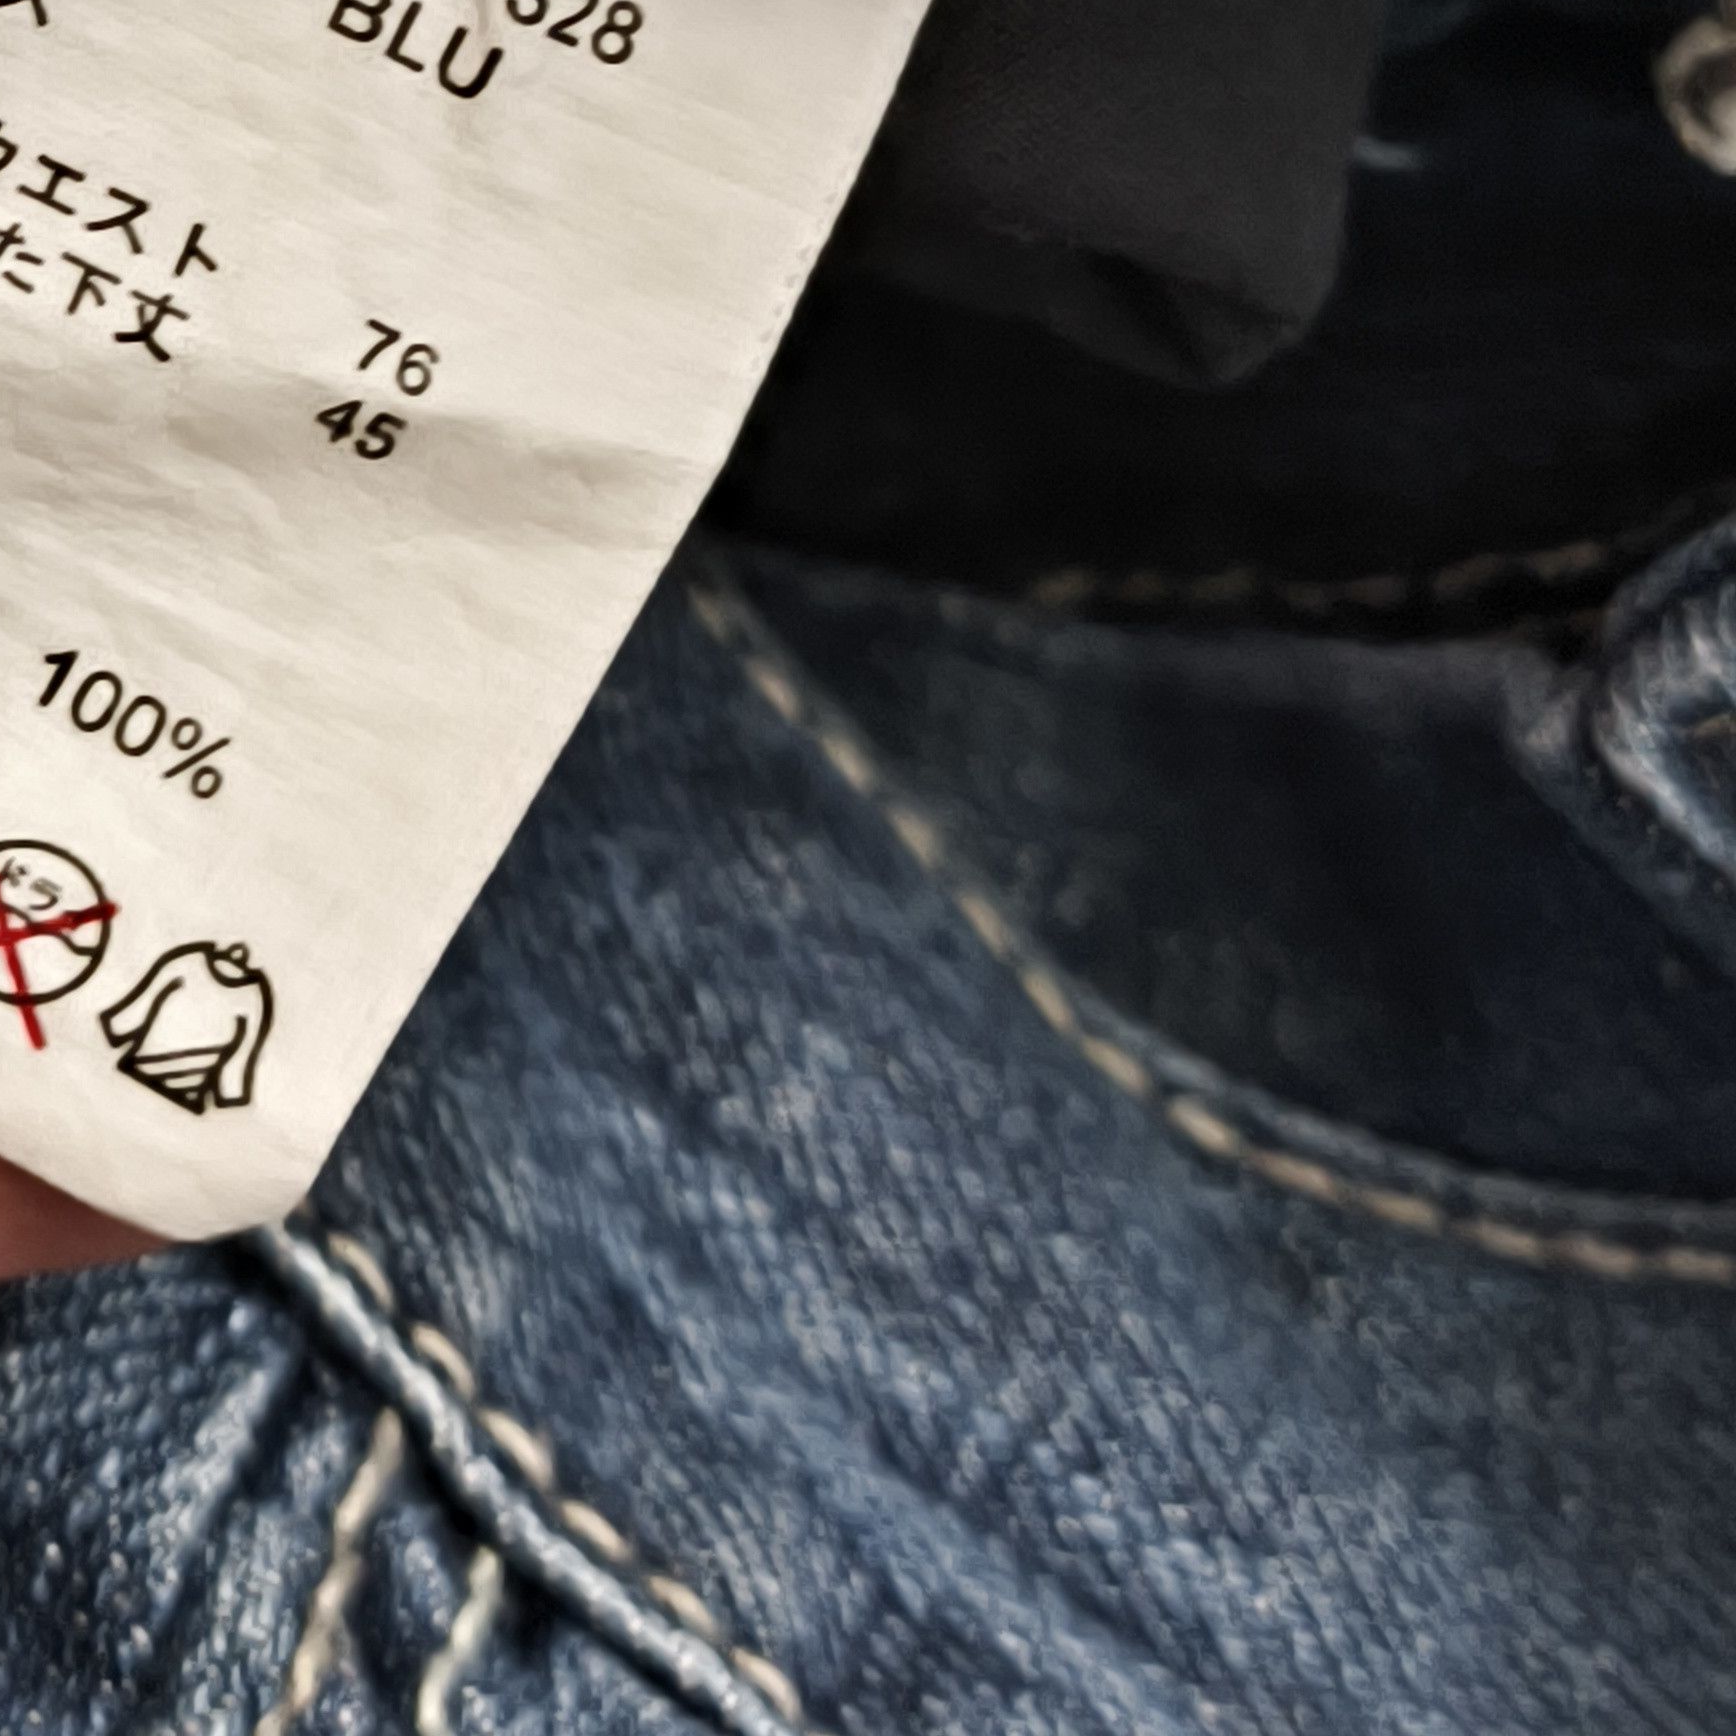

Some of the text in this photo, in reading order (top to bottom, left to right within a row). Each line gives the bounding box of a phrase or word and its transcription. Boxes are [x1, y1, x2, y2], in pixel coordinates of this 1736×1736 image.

[357, 318, 439, 397] 76
[314, 399, 408, 462] 45
[37, 649, 232, 801] 100%
